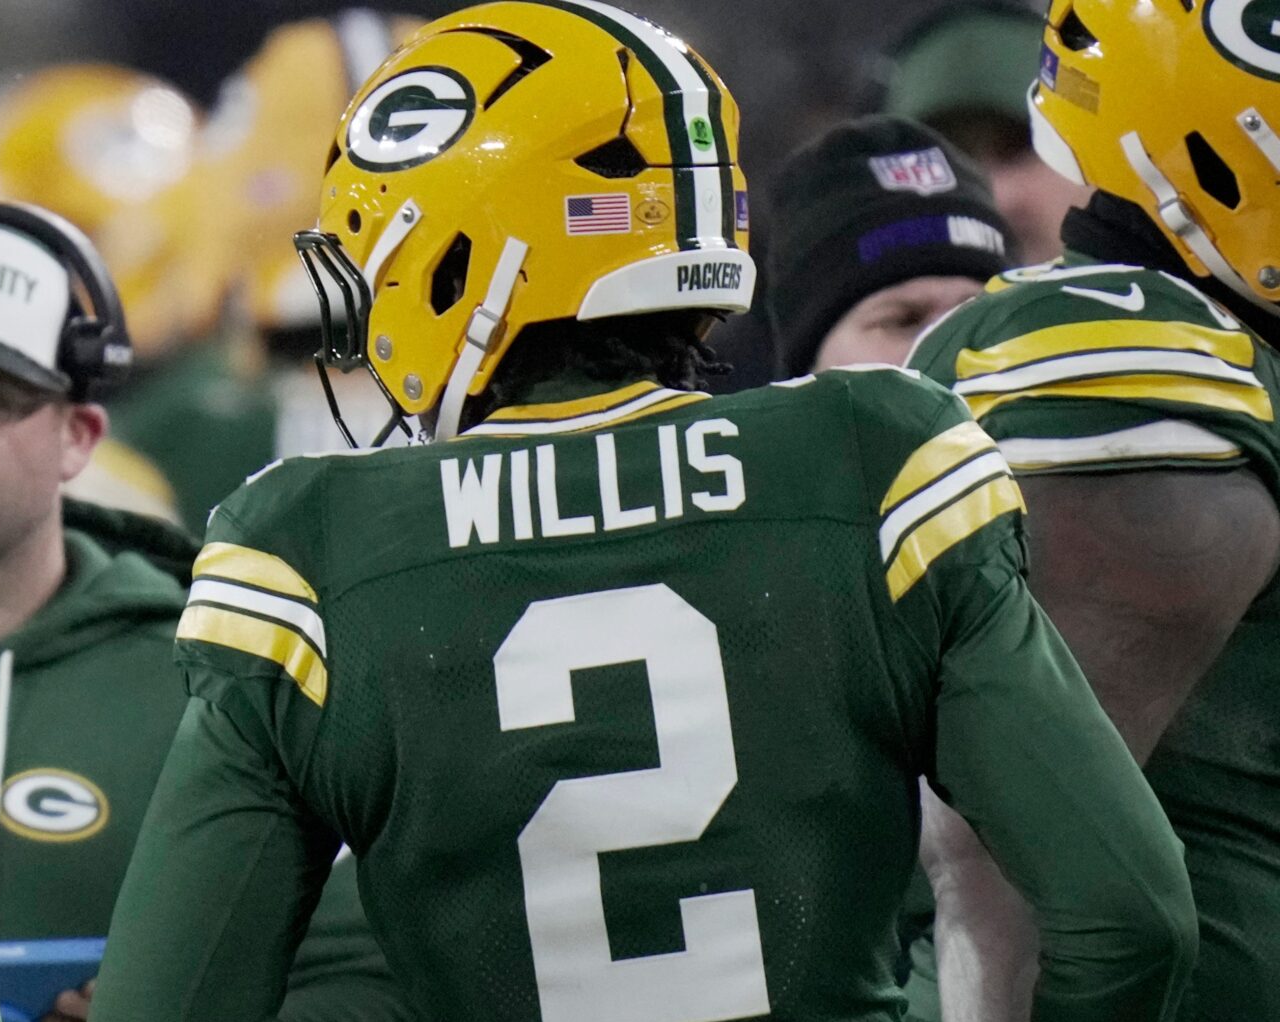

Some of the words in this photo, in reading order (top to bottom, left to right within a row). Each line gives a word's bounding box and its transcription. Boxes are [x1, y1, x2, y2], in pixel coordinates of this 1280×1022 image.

[348, 70, 468, 164] G
[677, 262, 742, 292] PACKERS
[440, 418, 746, 548] WILLIS
[3, 774, 98, 832] G
